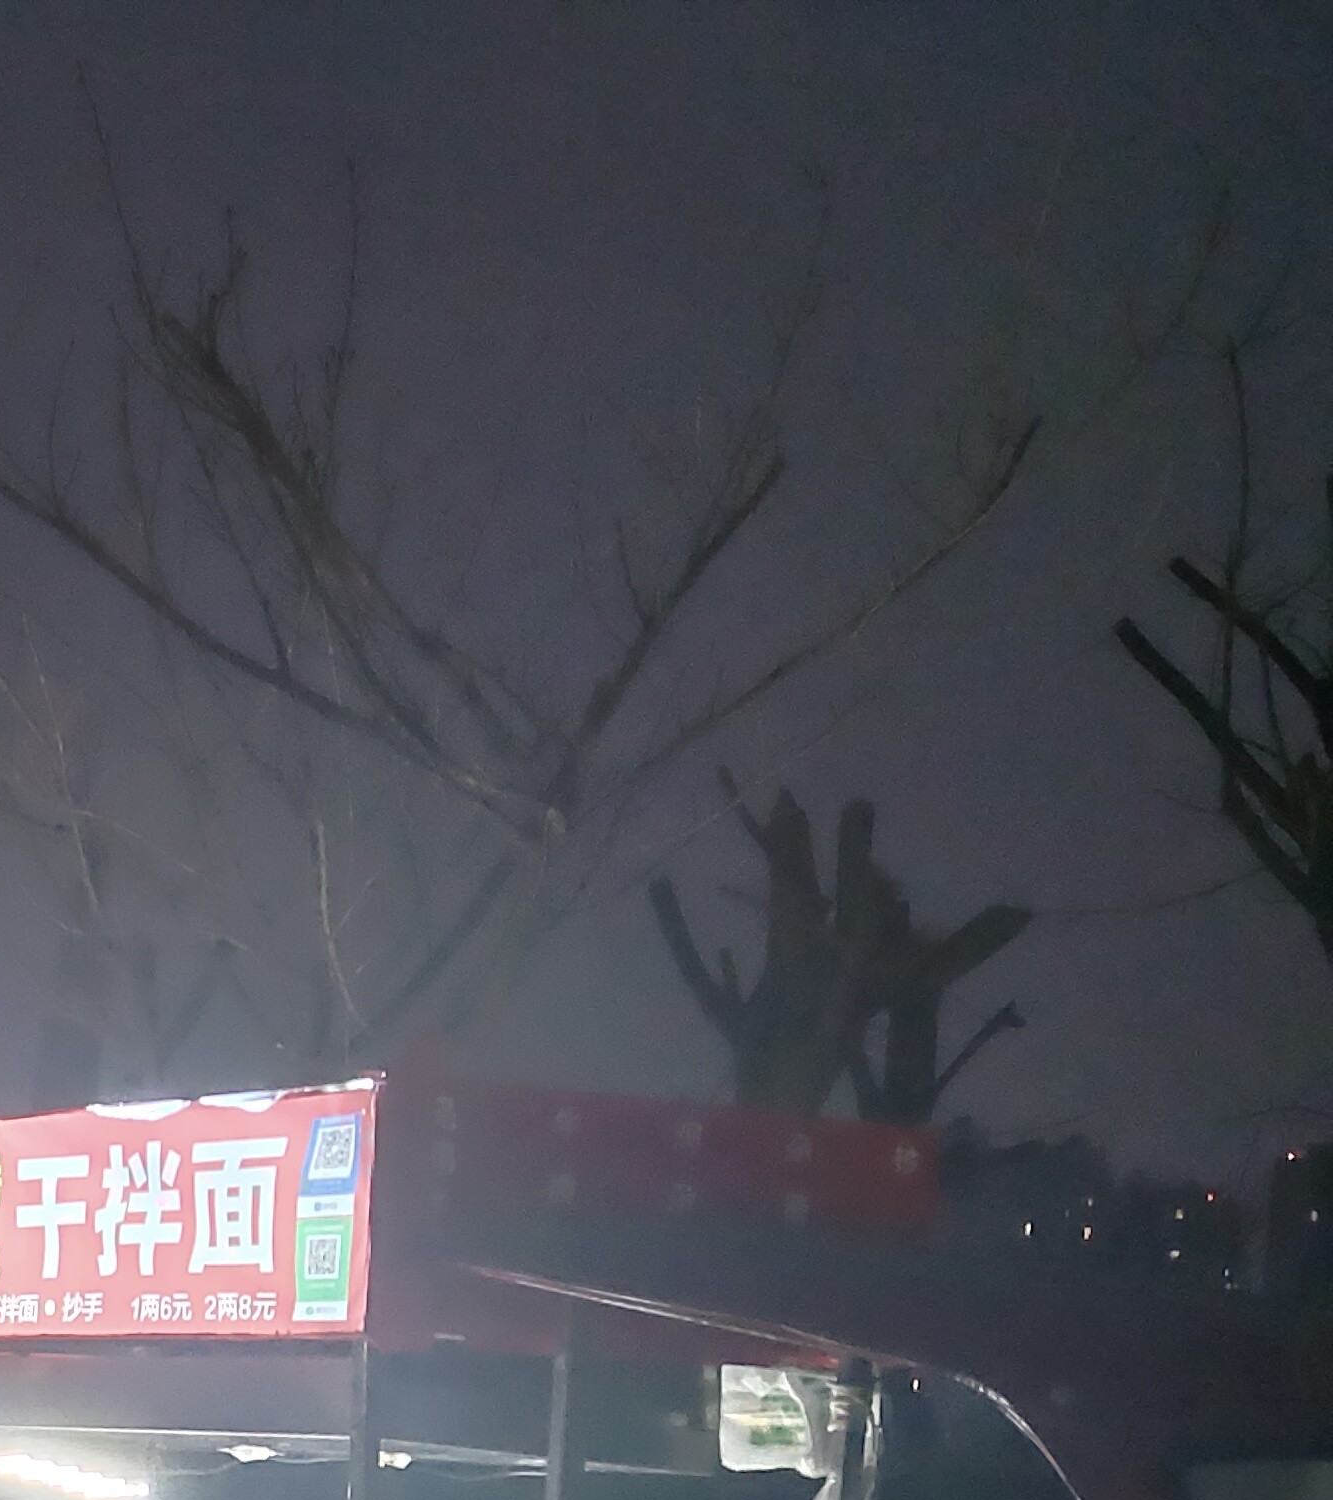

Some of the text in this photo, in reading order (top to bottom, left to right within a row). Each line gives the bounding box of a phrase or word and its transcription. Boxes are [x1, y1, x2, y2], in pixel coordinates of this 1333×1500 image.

[15, 1136, 289, 1279] 干拌面
[62, 1292, 104, 1322] 抄手
[131, 1293, 193, 1321] 1两6元
[204, 1292, 277, 1321] 2两8元
